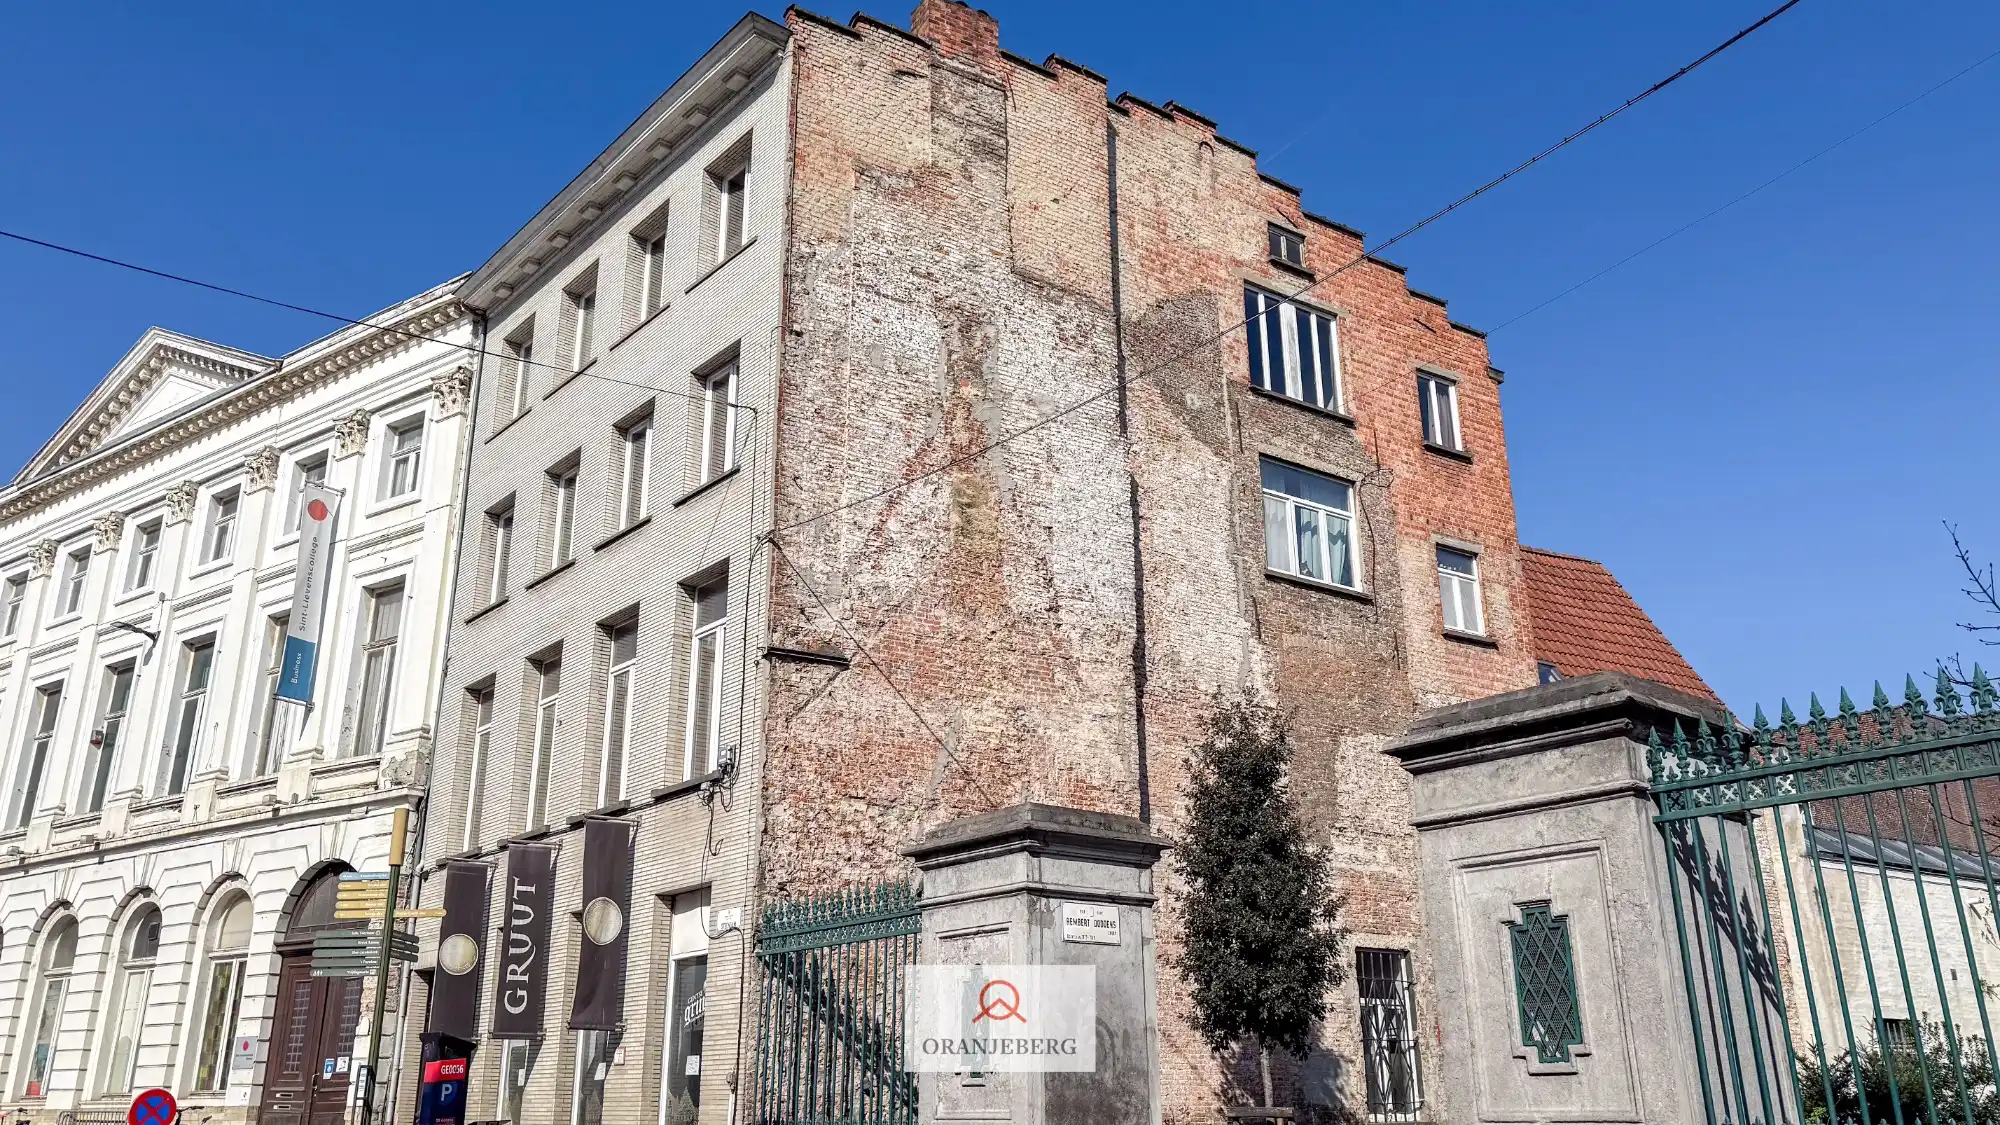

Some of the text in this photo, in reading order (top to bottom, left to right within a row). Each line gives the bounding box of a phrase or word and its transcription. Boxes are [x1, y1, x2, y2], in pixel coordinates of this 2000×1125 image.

[299, 536, 318, 631] Sint-Lievenscollege
[291, 653, 302, 684] Business
[504, 876, 537, 1015] GRUUT
[440, 1083, 453, 1102] P
